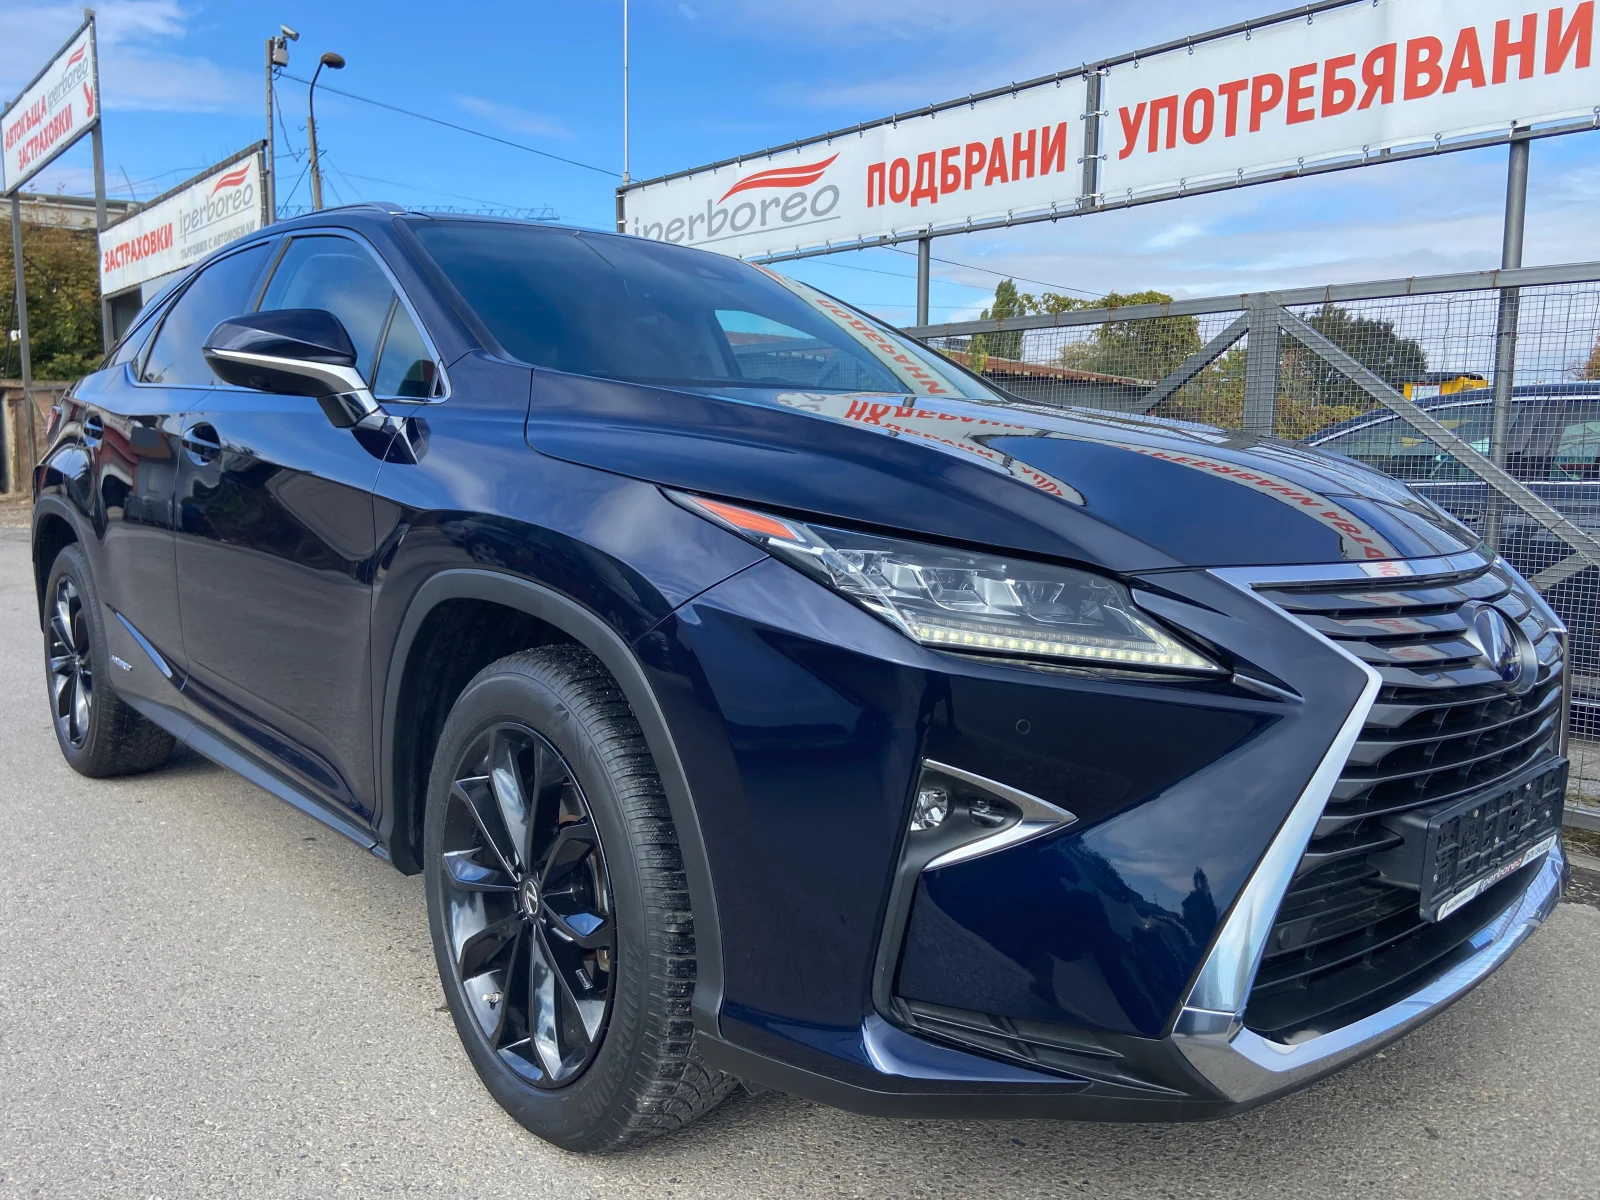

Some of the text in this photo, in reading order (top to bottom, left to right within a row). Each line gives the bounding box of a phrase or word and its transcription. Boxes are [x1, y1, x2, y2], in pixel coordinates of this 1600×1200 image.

[47, 57, 89, 115] iperboreo
[866, 0, 1596, 209] ПОДБРАНИ УПОТРЕБЯВАНИ
[5, 95, 47, 152] АВТОКЪЩА
[18, 103, 73, 172] ЗАСТРАХОВКИ
[179, 183, 254, 244] iperboreo
[104, 222, 173, 273] ЗАСТРАХОВКИ
